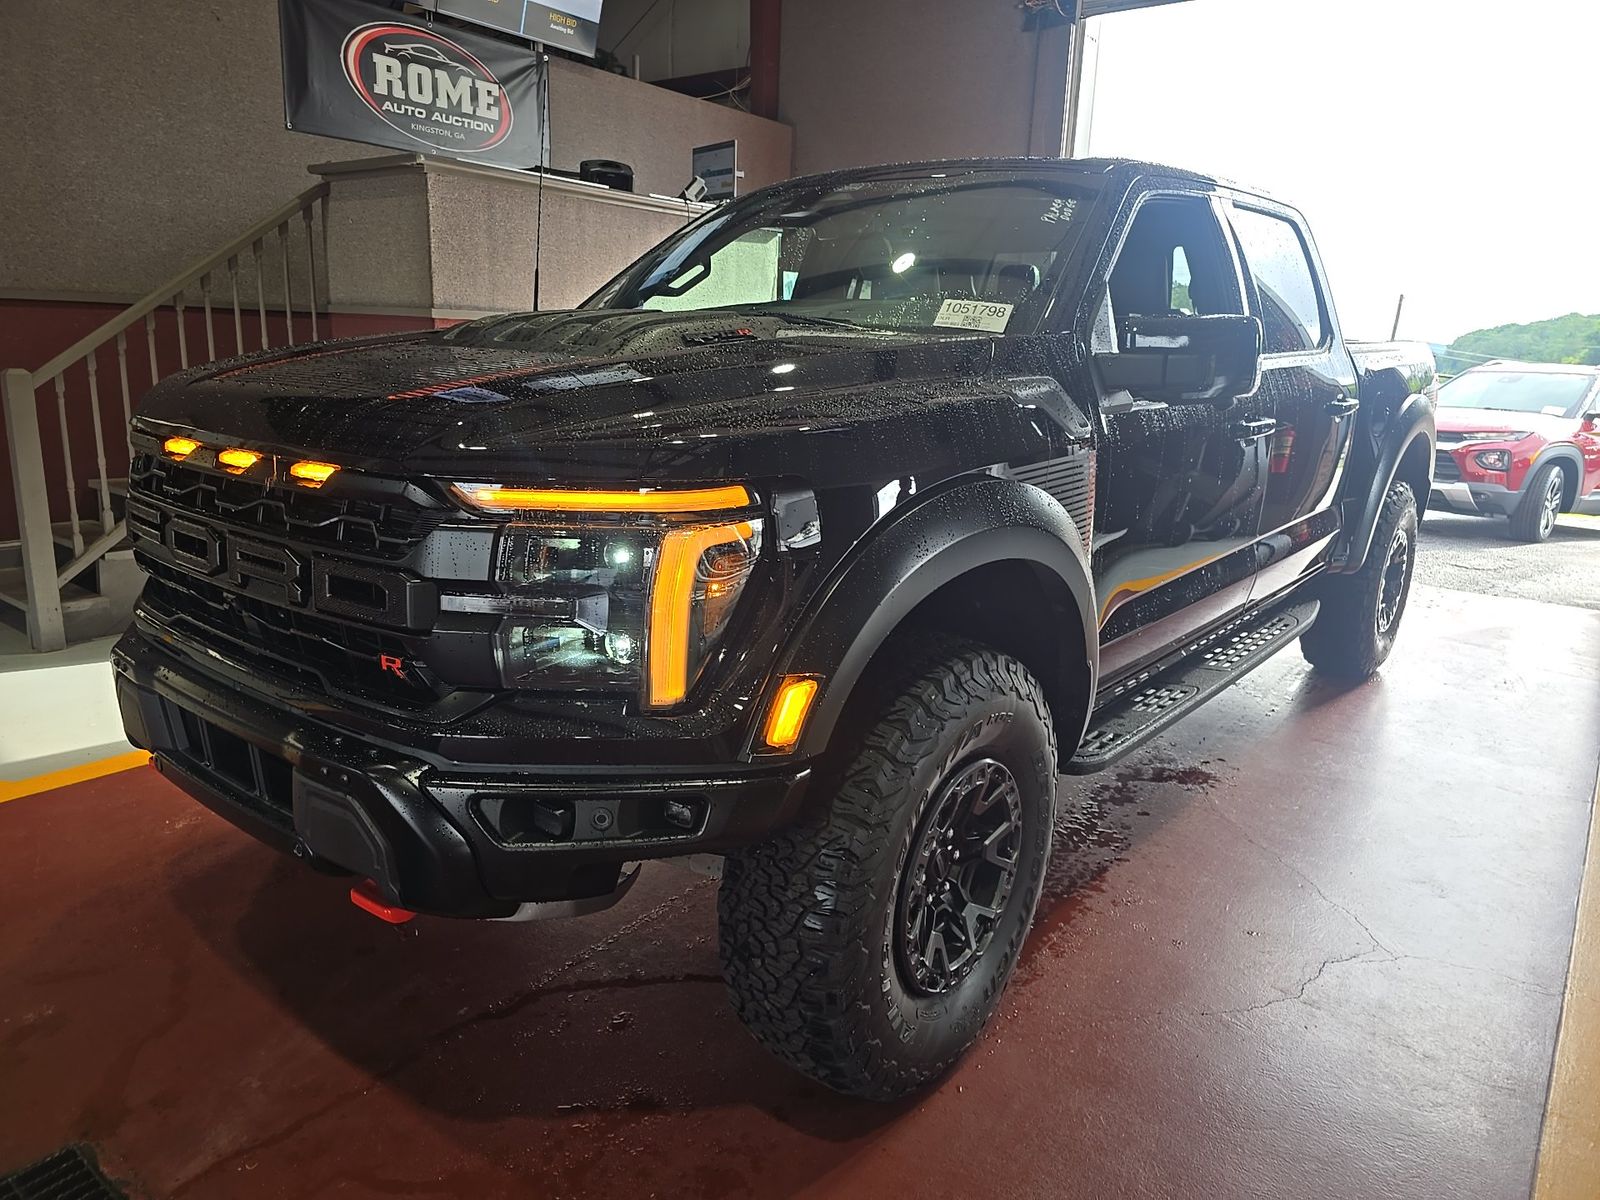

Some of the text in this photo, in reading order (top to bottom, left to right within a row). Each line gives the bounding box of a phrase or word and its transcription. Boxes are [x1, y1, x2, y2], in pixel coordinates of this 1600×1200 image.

[549, 11, 577, 28] HIGH BID
[372, 53, 499, 120] ROME
[381, 101, 495, 134] AUTO AUCTION
[410, 122, 466, 140] KINGSTON, GA
[945, 302, 1007, 318] 1051798
[380, 654, 406, 679] R
